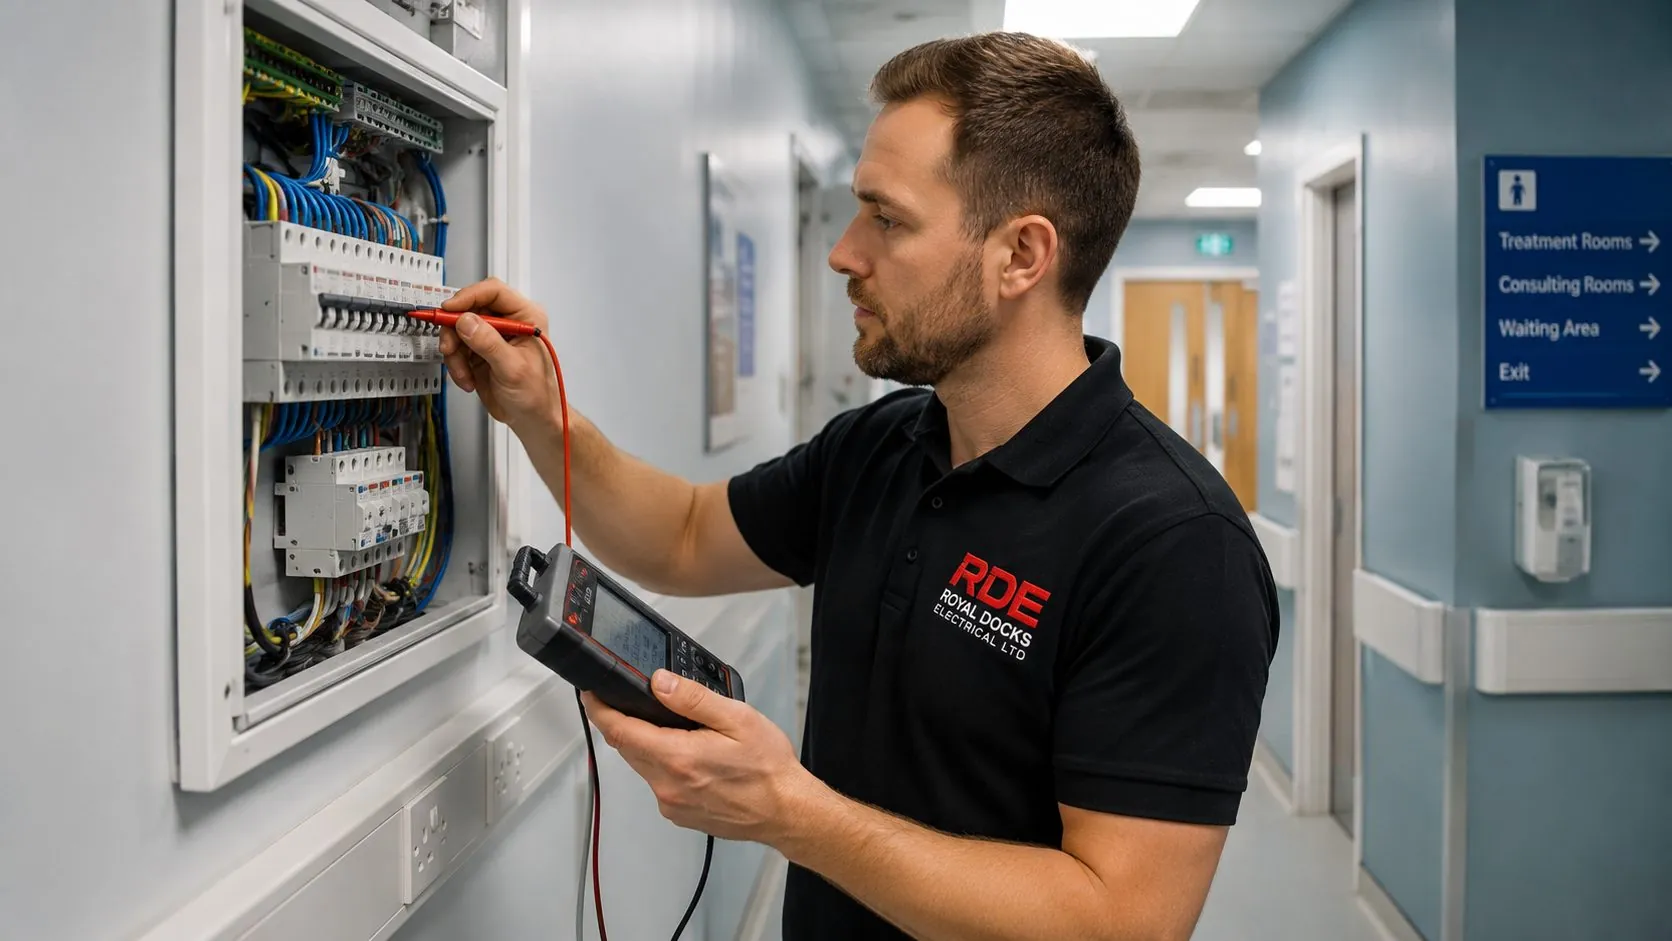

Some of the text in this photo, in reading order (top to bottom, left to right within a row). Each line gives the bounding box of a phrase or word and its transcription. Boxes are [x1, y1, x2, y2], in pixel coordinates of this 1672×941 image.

[1499, 231, 1633, 250] Treatment Rooms
[1498, 275, 1634, 297] Consulting Rooms
[1498, 318, 1600, 341] Waiting Area
[1499, 362, 1530, 381] Exit
[949, 552, 1052, 629] RDE
[939, 588, 1033, 648] ROYAL DOCKS
[933, 604, 1026, 661] ELECTRICAL LTD
